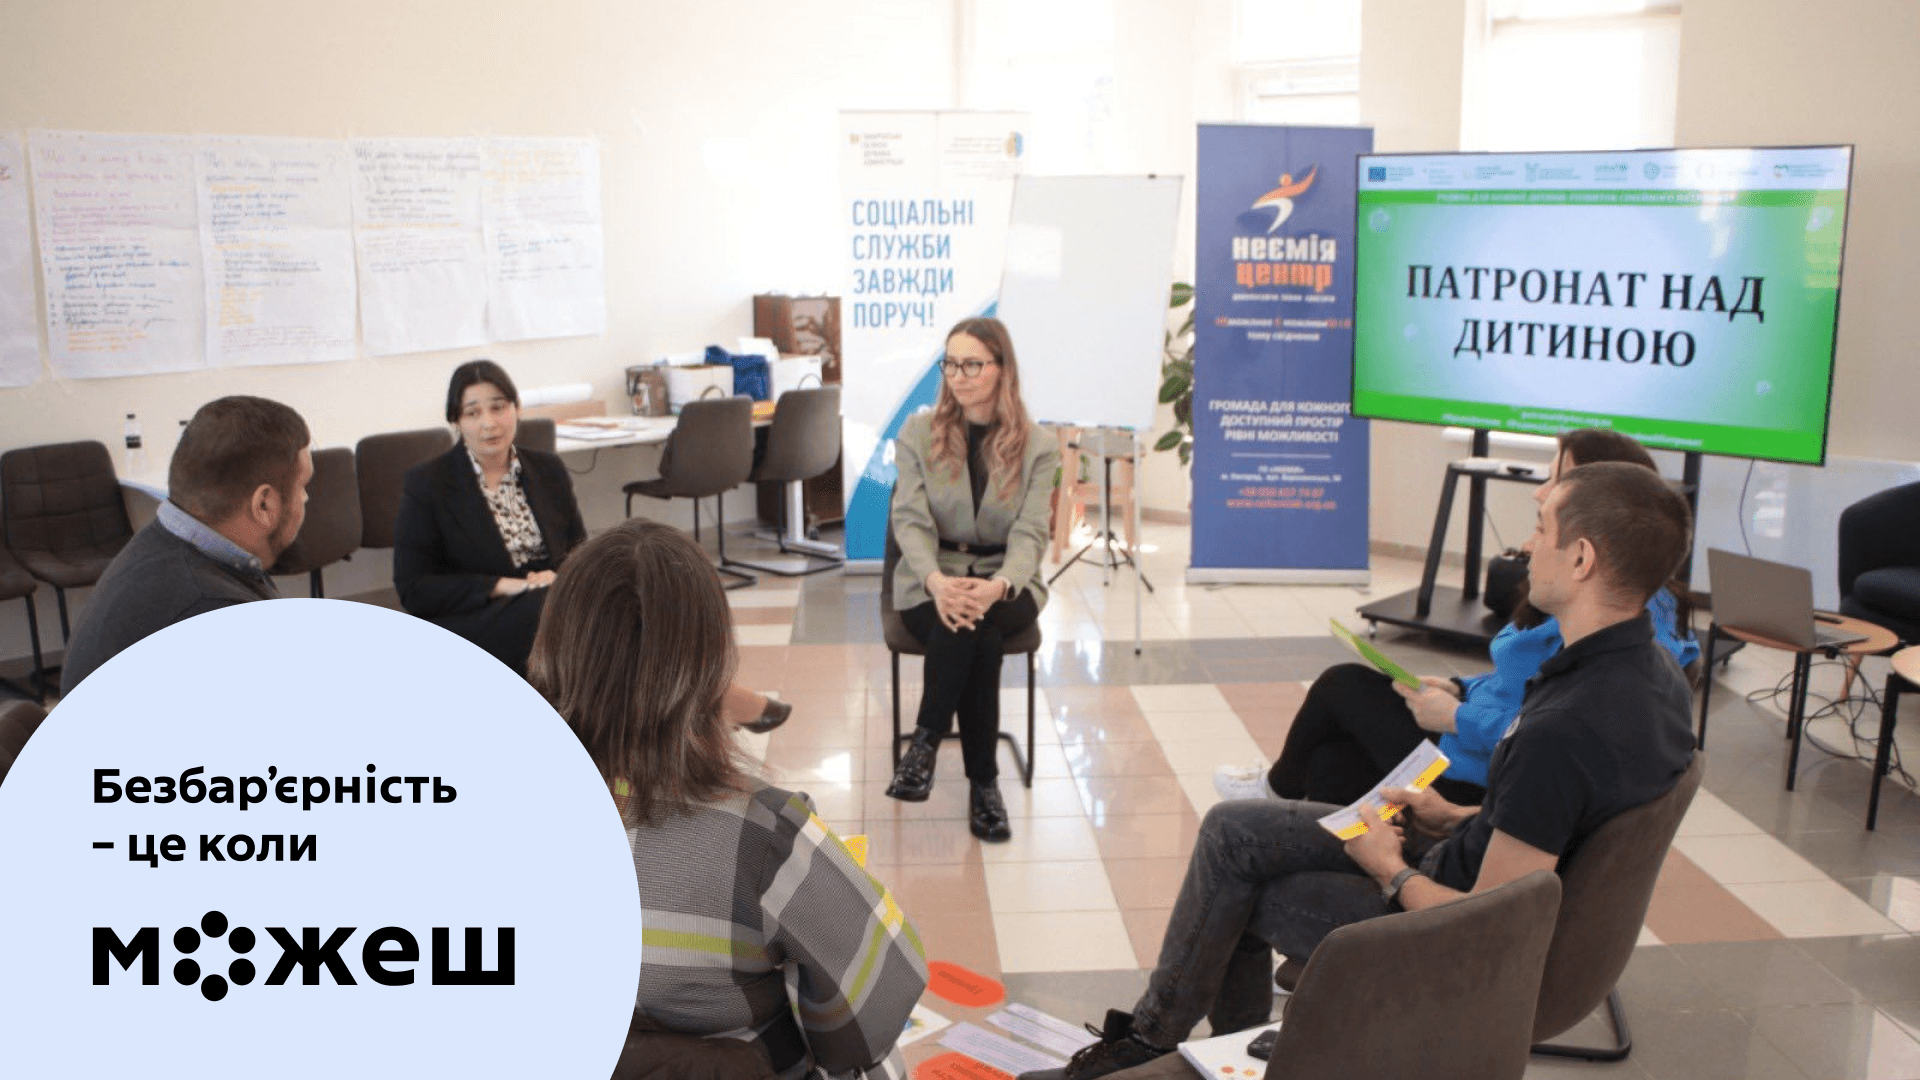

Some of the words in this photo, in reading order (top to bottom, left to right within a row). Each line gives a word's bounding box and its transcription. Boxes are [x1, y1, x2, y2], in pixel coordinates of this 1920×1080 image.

[852, 200, 974, 229] СОЦІАЛЬНІ
[852, 233, 952, 260] СЛУЖБИ
[853, 267, 955, 297] ЗАВЖДИ
[1406, 264, 1647, 308] ПАТРОНАТ
[1661, 273, 1765, 324] НАД
[853, 302, 935, 328] ПОРУЧ!
[1453, 318, 1697, 368] ДИТИНОЮ
[1209, 400, 1267, 413] ГРОМАДА
[1270, 401, 1295, 413] ДЛЯ
[1220, 414, 1293, 427] ДОСТУПНИЙ
[1295, 416, 1344, 428] ПРОСТІР
[1225, 430, 1255, 441] РІВНІ
[1258, 431, 1339, 443] МОЖЛИВОСТІ
